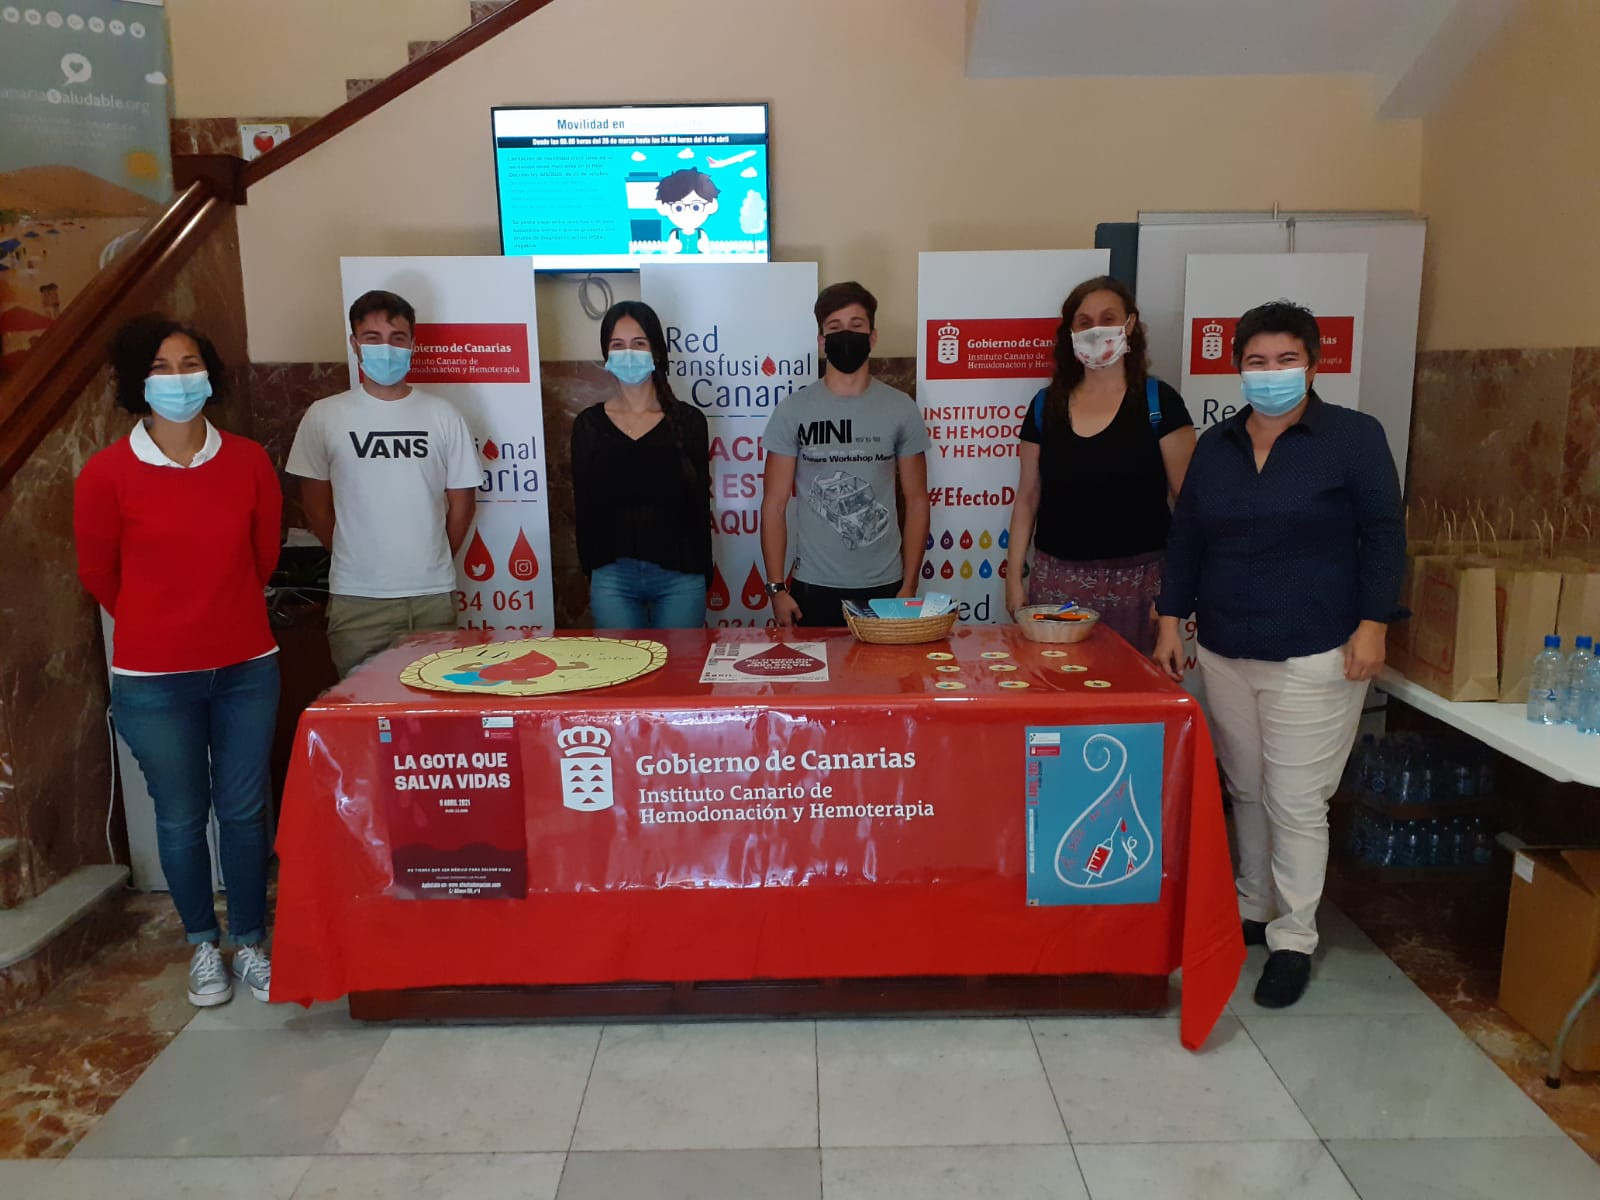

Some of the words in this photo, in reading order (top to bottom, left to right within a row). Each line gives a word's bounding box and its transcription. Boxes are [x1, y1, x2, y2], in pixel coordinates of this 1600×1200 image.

[557, 118, 609, 130] Movilidad
[612, 120, 625, 130] en
[413, 344, 449, 353] bierno
[450, 343, 463, 353] de
[464, 343, 512, 353] Canarias
[666, 325, 718, 353] Red
[967, 338, 1017, 349] Gobierno
[1018, 338, 1031, 348] de
[1319, 336, 1337, 345] rias
[436, 357, 467, 365] Canario
[469, 357, 479, 365] de
[1003, 352, 1034, 360] Canario
[462, 367, 467, 375] y
[469, 365, 520, 375] Hemoterapia
[924, 405, 1011, 420] INSTITUTO
[1014, 405, 1026, 419] C
[1203, 398, 1236, 425] Re
[798, 419, 852, 446] MINI
[947, 425, 1022, 439] HEMODO
[349, 431, 429, 459] VANS
[939, 444, 949, 458] Y
[829, 454, 873, 463] Workshop
[477, 464, 539, 492] aria
[928, 486, 1015, 507] #EfectoD
[711, 509, 758, 536] AQU
[456, 590, 483, 612] 34
[492, 590, 534, 612] 061
[957, 594, 990, 622] ed
[1185, 621, 1197, 640] 9
[393, 755, 417, 770] LA
[420, 753, 469, 769] GOTA
[472, 752, 508, 769] QUE
[636, 753, 760, 776] Gobierno
[765, 750, 796, 771] de
[801, 747, 916, 771] Canarias
[394, 774, 454, 790] SALVA
[456, 773, 511, 789] VIDAS
[639, 786, 725, 804] Instituto
[730, 783, 805, 801] Canario
[810, 782, 833, 798] de
[640, 803, 787, 824] Hemodonación
[792, 807, 804, 824] y
[810, 800, 935, 821] Hemoterapia
